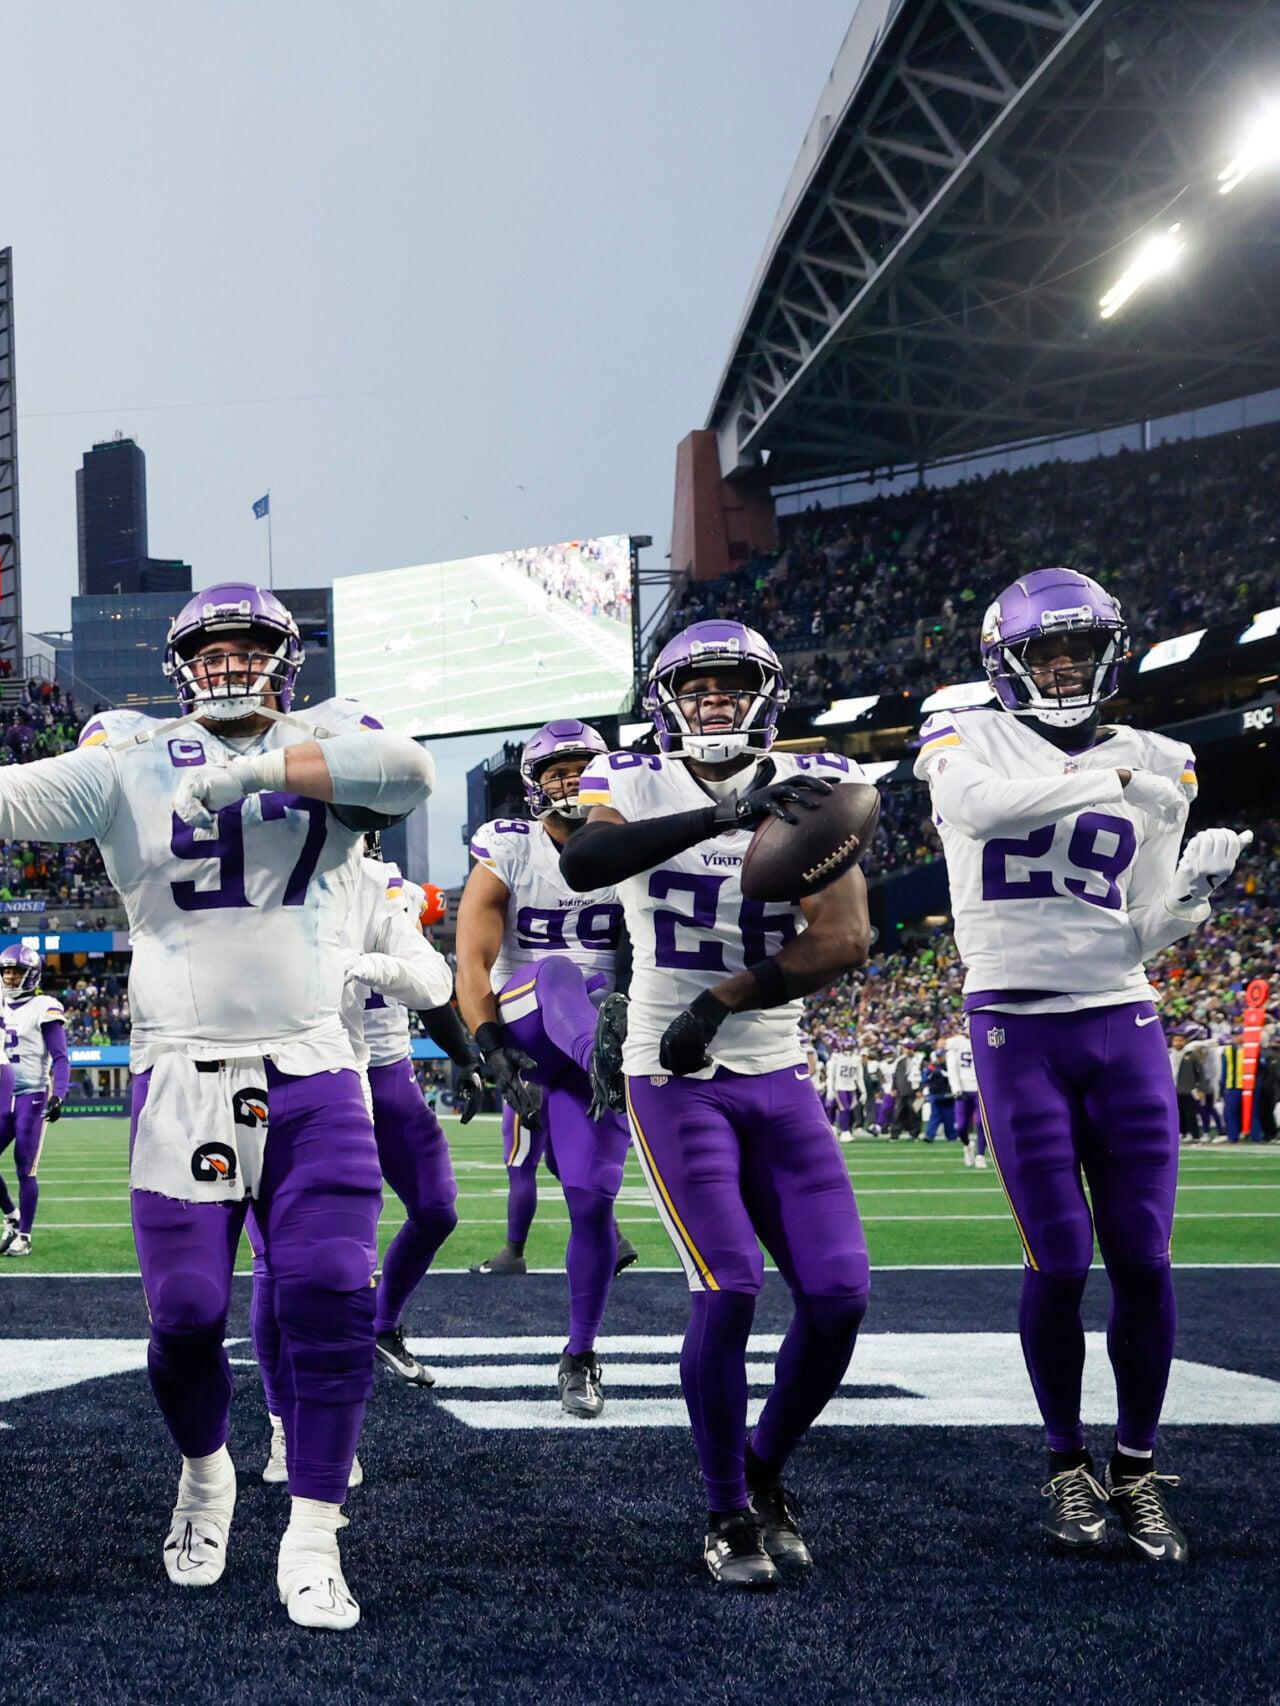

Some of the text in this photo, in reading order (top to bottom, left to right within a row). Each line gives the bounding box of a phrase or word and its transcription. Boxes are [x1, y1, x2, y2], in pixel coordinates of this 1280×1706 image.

[171, 791, 328, 911] 97
[701, 851, 743, 867] VIKIN
[982, 811, 1137, 910] 29
[4, 901, 46, 912] NOISE!
[517, 904, 624, 951] 99
[648, 869, 799, 972] 26
